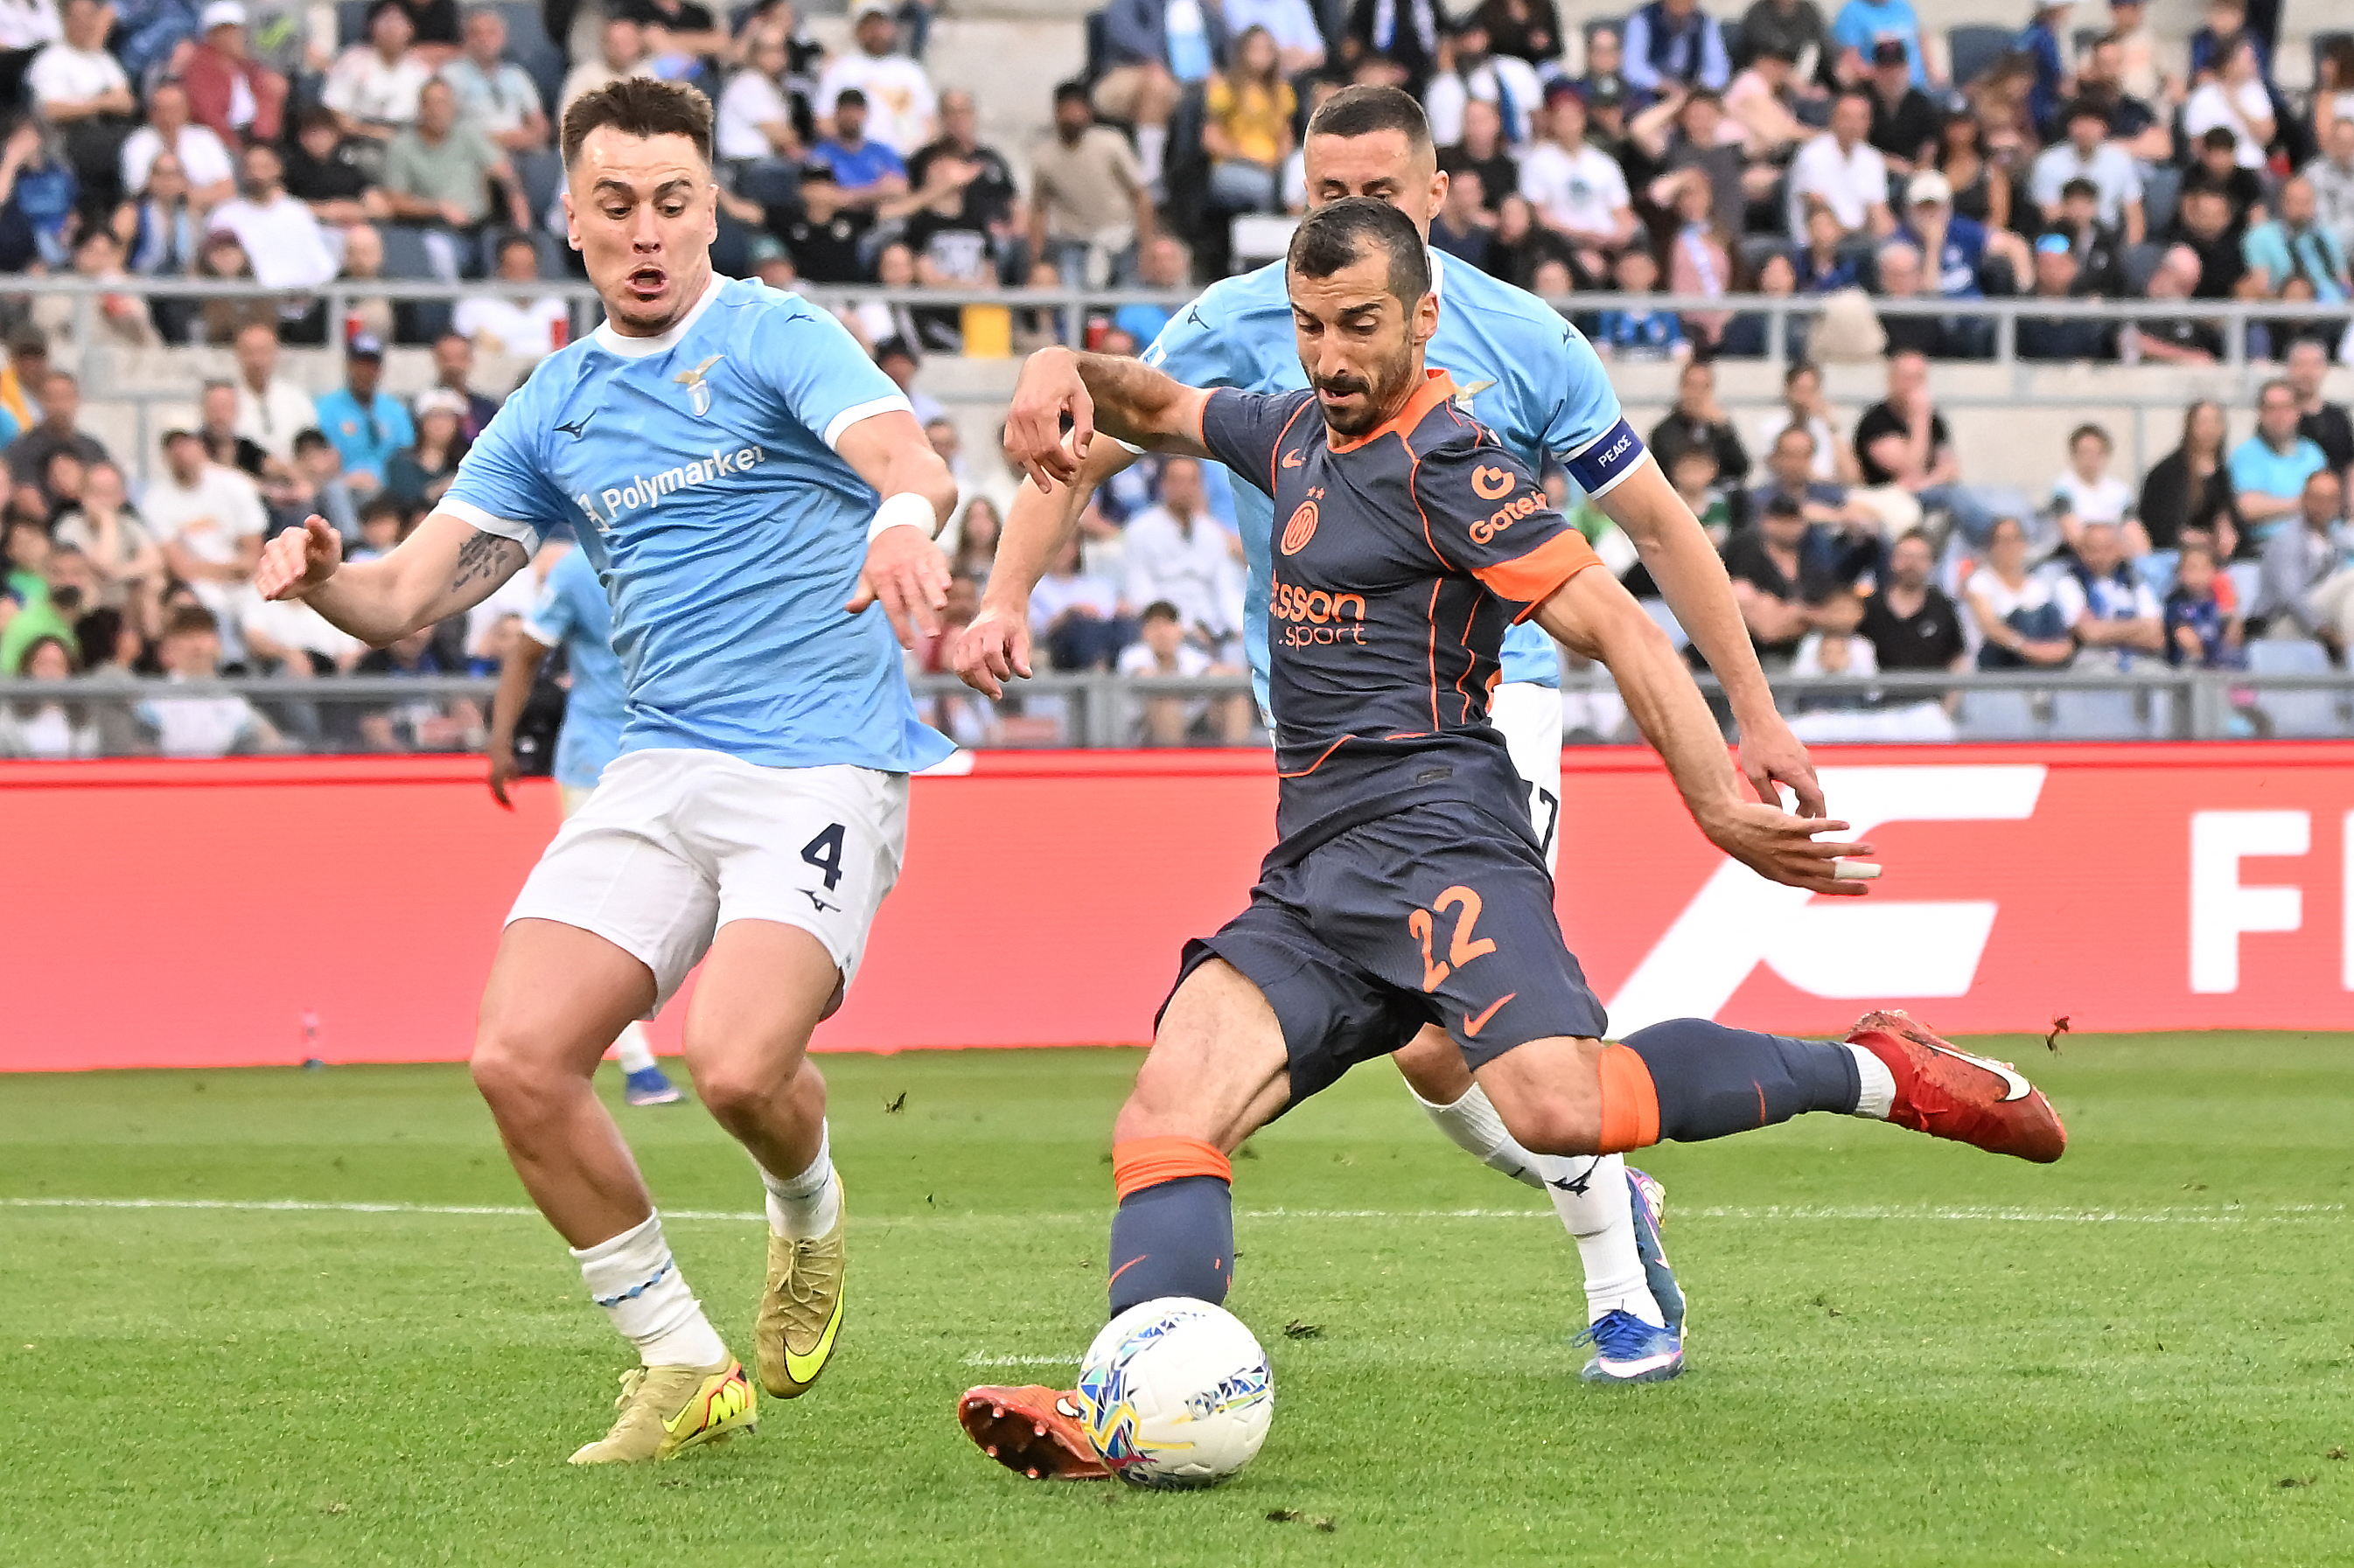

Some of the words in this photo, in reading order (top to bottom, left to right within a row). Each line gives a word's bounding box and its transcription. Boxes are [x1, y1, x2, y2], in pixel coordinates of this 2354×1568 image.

[1597, 434, 1632, 468] PEACE
[800, 822, 846, 892] 4
[1408, 885, 1497, 993] 22
[2190, 810, 2354, 994] F
